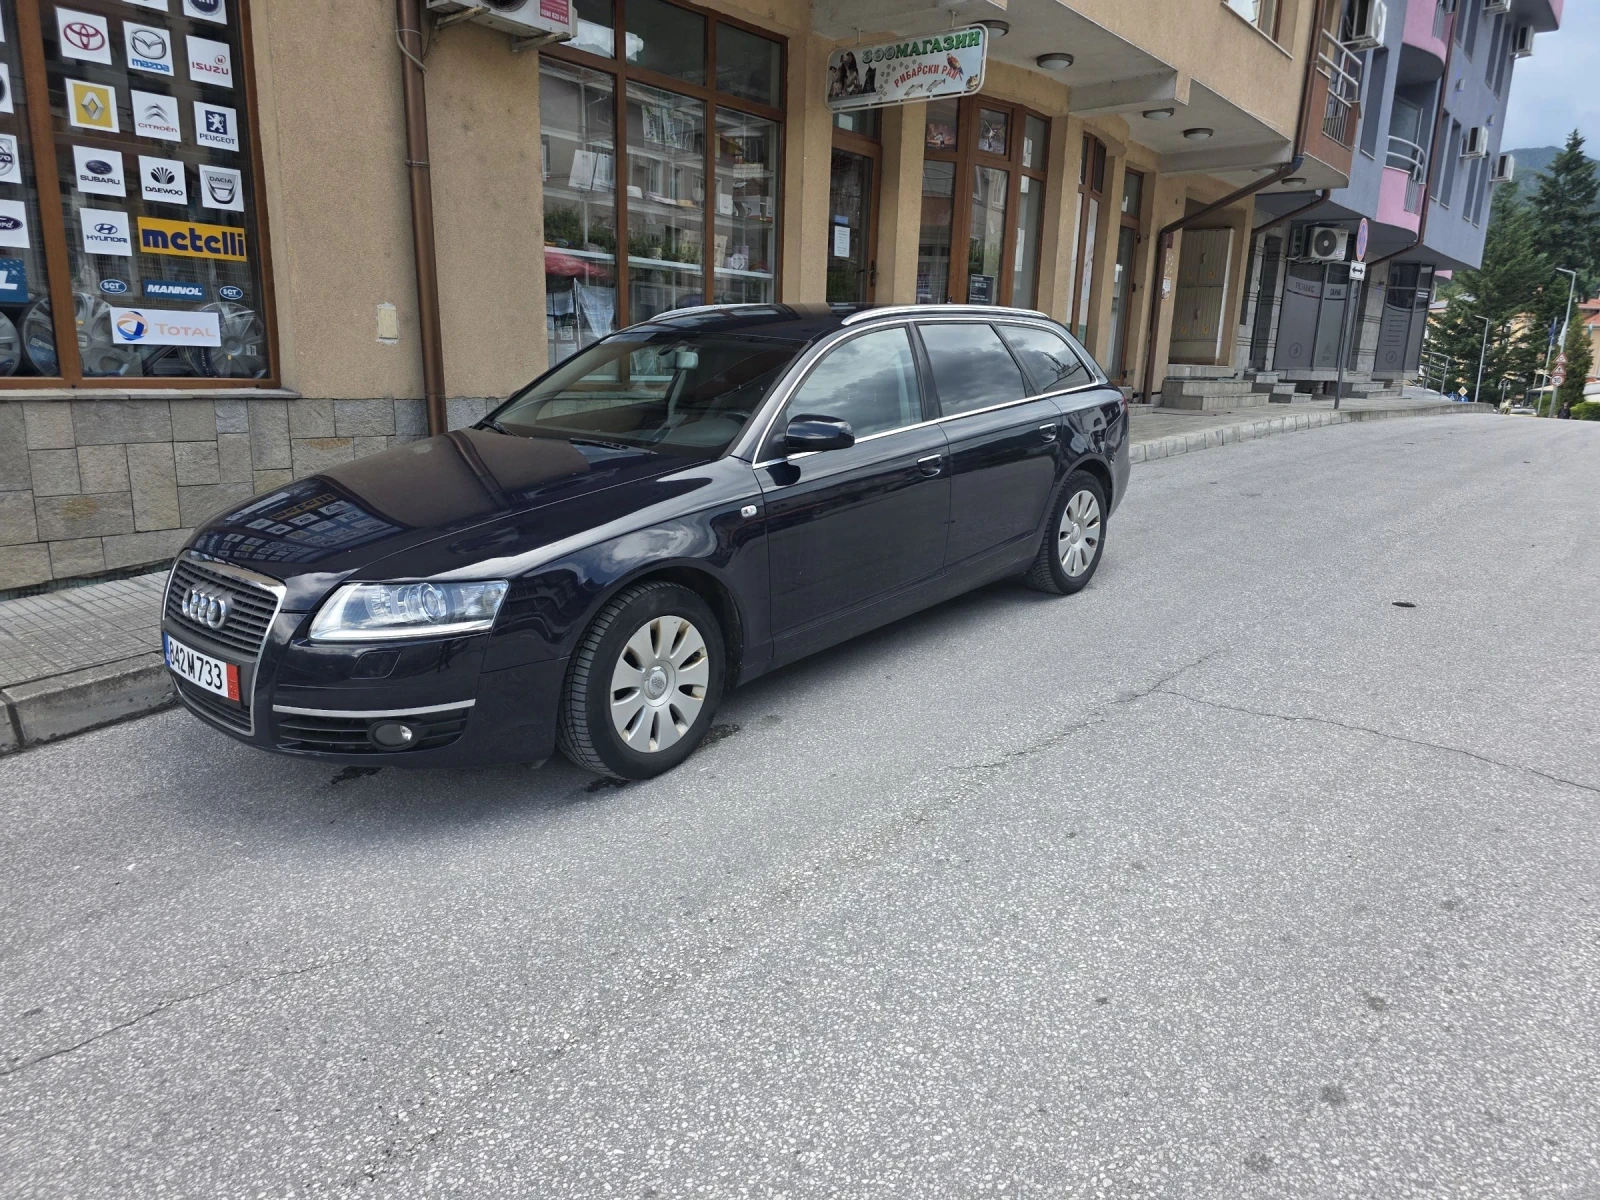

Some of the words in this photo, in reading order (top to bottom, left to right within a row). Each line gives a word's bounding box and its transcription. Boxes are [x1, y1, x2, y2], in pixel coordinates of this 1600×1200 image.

[862, 30, 981, 64] ЗООМАГАЗИН
[191, 61, 229, 76] ISUZU
[893, 64, 940, 88] РИБАРСКИ
[199, 132, 236, 146] PEUGEOT
[80, 174, 120, 185] SUBARU
[209, 176, 233, 184] DACIA
[145, 186, 183, 197] DAEWOO
[86, 234, 128, 244] HYUNDAI
[142, 227, 245, 257] metelli
[147, 284, 202, 296] MANNOL
